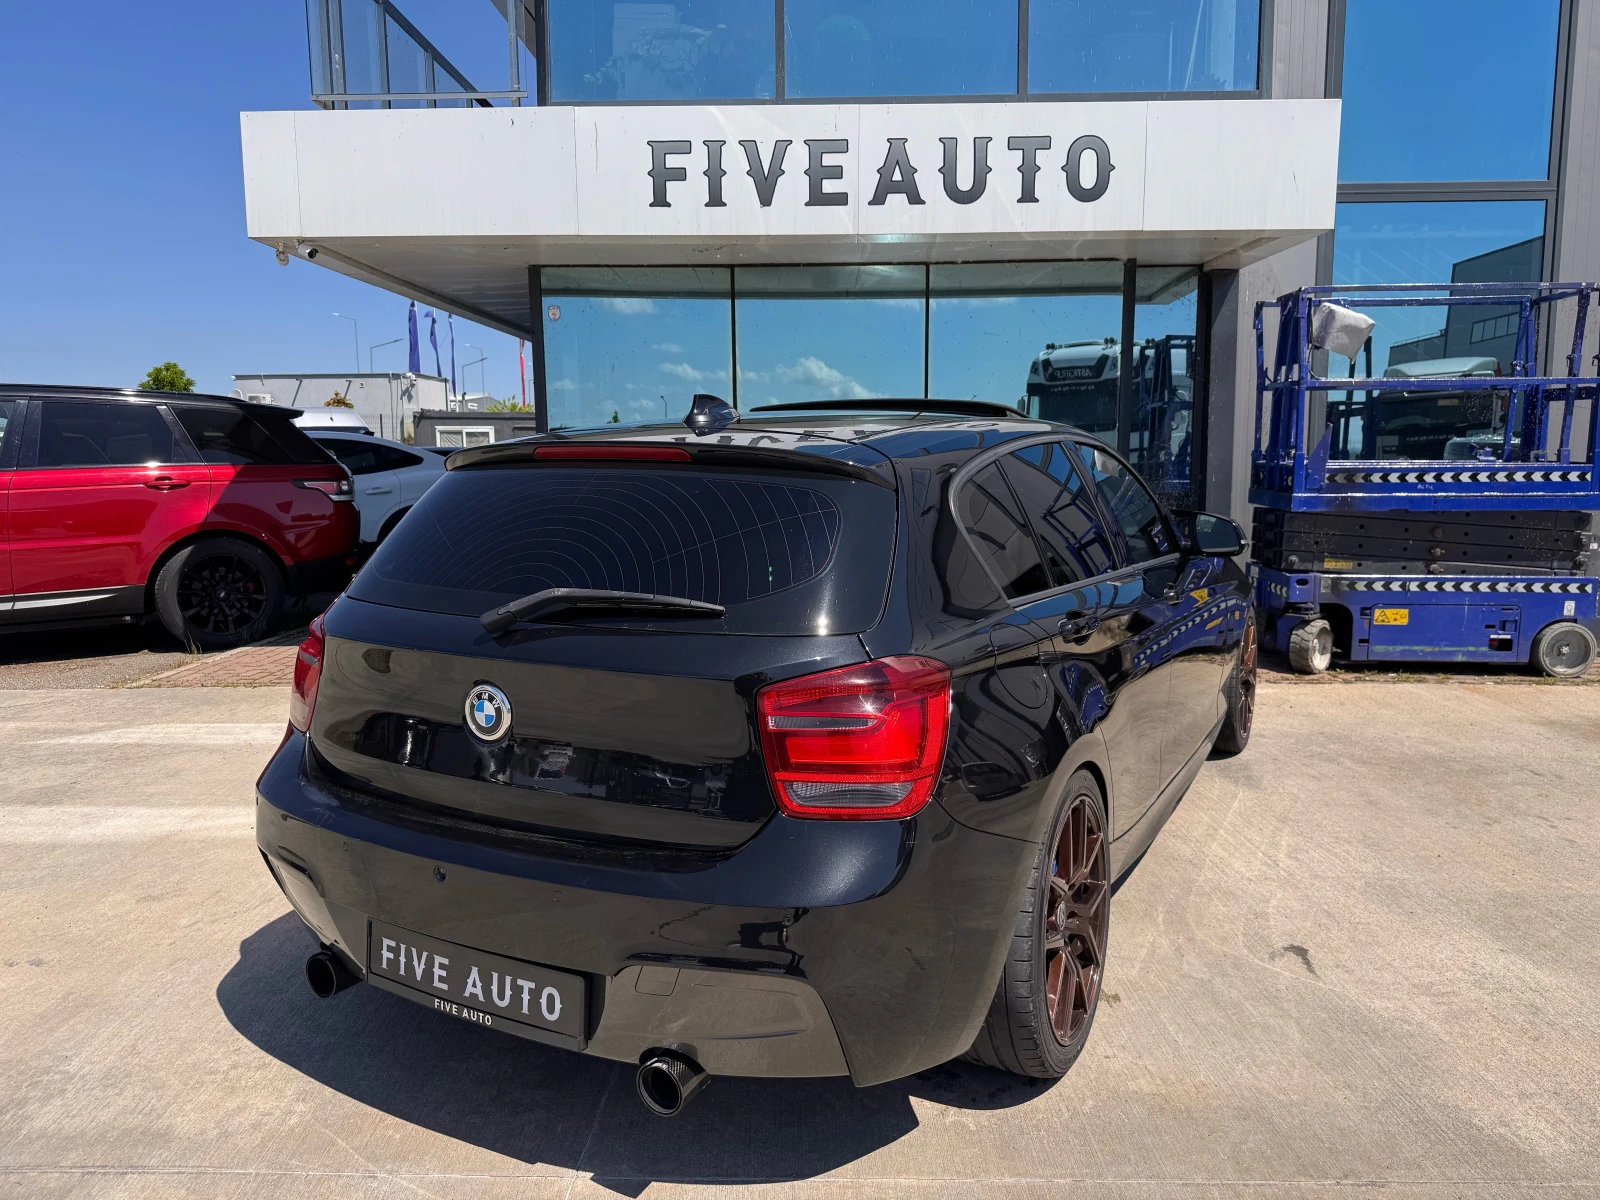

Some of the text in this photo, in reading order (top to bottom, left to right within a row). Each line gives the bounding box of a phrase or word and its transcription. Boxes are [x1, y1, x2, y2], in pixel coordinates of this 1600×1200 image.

[471, 692, 500, 708] BMW
[381, 937, 563, 1022] FIVE AUTO
[434, 998, 492, 1025] FIVE AUTO
